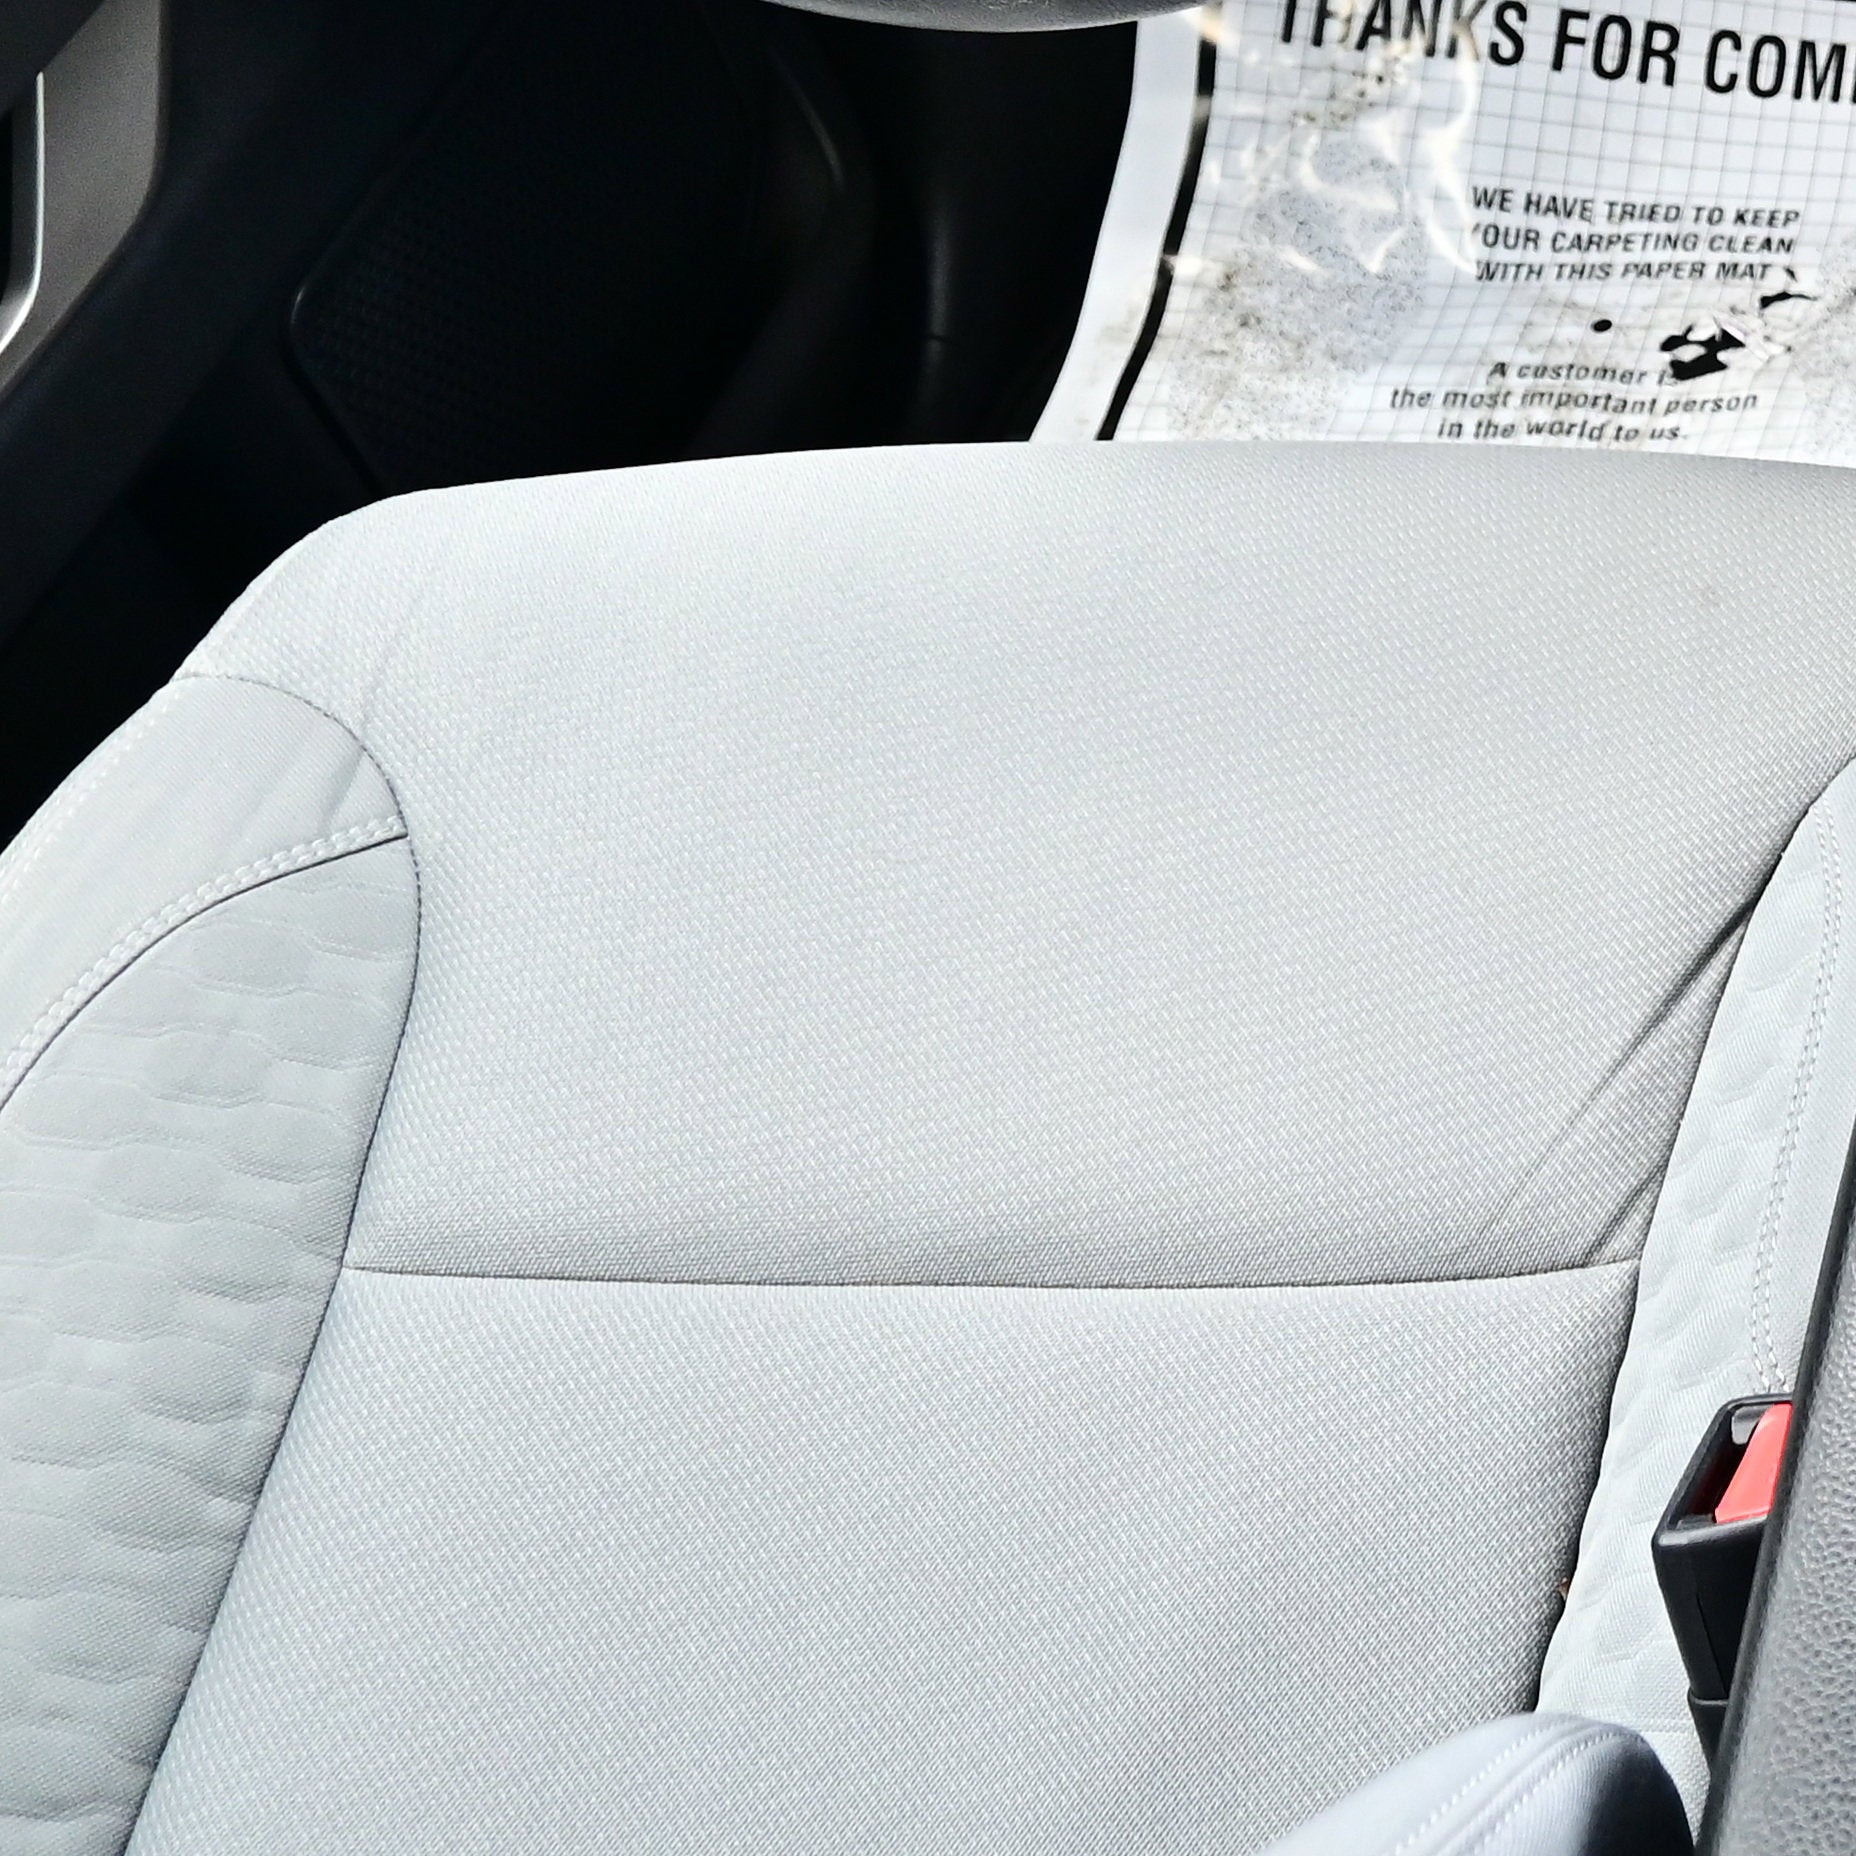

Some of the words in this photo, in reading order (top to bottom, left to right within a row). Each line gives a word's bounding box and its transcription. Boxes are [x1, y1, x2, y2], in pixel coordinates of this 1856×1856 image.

[1551, 7, 1682, 88] FOR
[1471, 184, 1515, 213] WE
[1523, 192, 1596, 223] HAVE
[1604, 199, 1682, 224] TRIED
[1691, 205, 1724, 226] TO
[1734, 207, 1801, 229] KEEP
[1551, 231, 1699, 255] CARPETING
[1708, 233, 1796, 255] CLEAN
[1475, 261, 1545, 283] WITH
[1554, 261, 1614, 282] THIS
[1620, 261, 1707, 282] PAPER
[1714, 261, 1773, 282] MAT
[1486, 361, 1507, 380] A
[1516, 363, 1649, 386] customer
[1390, 388, 1432, 409] the
[1442, 390, 1513, 409] most
[1520, 390, 1659, 415] important
[1663, 392, 1758, 417] person
[1437, 418, 1463, 439] in
[1472, 418, 1515, 439] the
[1525, 420, 1605, 443] world
[1615, 423, 1640, 443] to
[1649, 426, 1690, 442] us.
